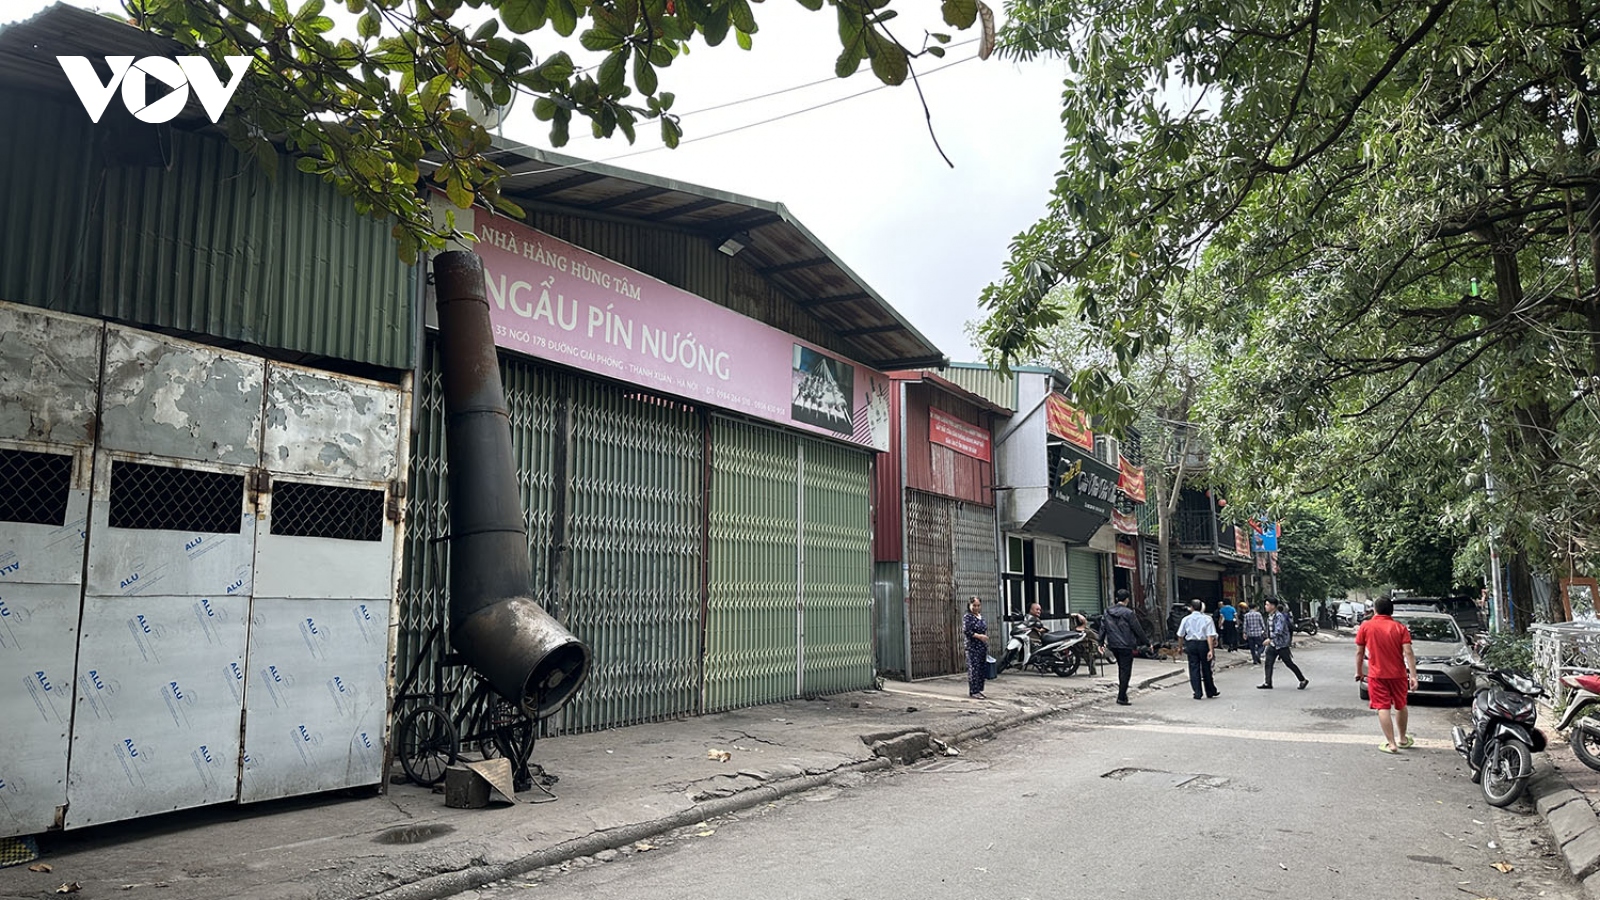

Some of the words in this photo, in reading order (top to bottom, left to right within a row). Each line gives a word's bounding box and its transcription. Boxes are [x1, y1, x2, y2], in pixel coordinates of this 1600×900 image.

[481, 225, 519, 254] NHÀ
[523, 242, 567, 272] HÀNG
[571, 260, 611, 289] HÙNG
[613, 277, 642, 301] TÂM
[495, 324, 507, 336] 33
[532, 335, 546, 348] 178
[588, 303, 633, 350] PÍN
[641, 324, 730, 381] NƯỚNG
[186, 536, 202, 551] ALU
[120, 573, 139, 588] ALU
[226, 580, 243, 594] ALU
[202, 599, 214, 617] ALU
[359, 604, 370, 621] ALU
[137, 614, 151, 634] ALU
[306, 618, 318, 635] ALU
[89, 670, 104, 690] ALU
[230, 662, 243, 680] ALU
[269, 665, 282, 683] ALU
[35, 670, 52, 691] ALU
[334, 676, 345, 693] ALU
[170, 681, 183, 700] ALU
[299, 725, 311, 742] ALU
[361, 732, 372, 748] ALU
[124, 738, 138, 758] ALU
[200, 745, 213, 763] ALU
